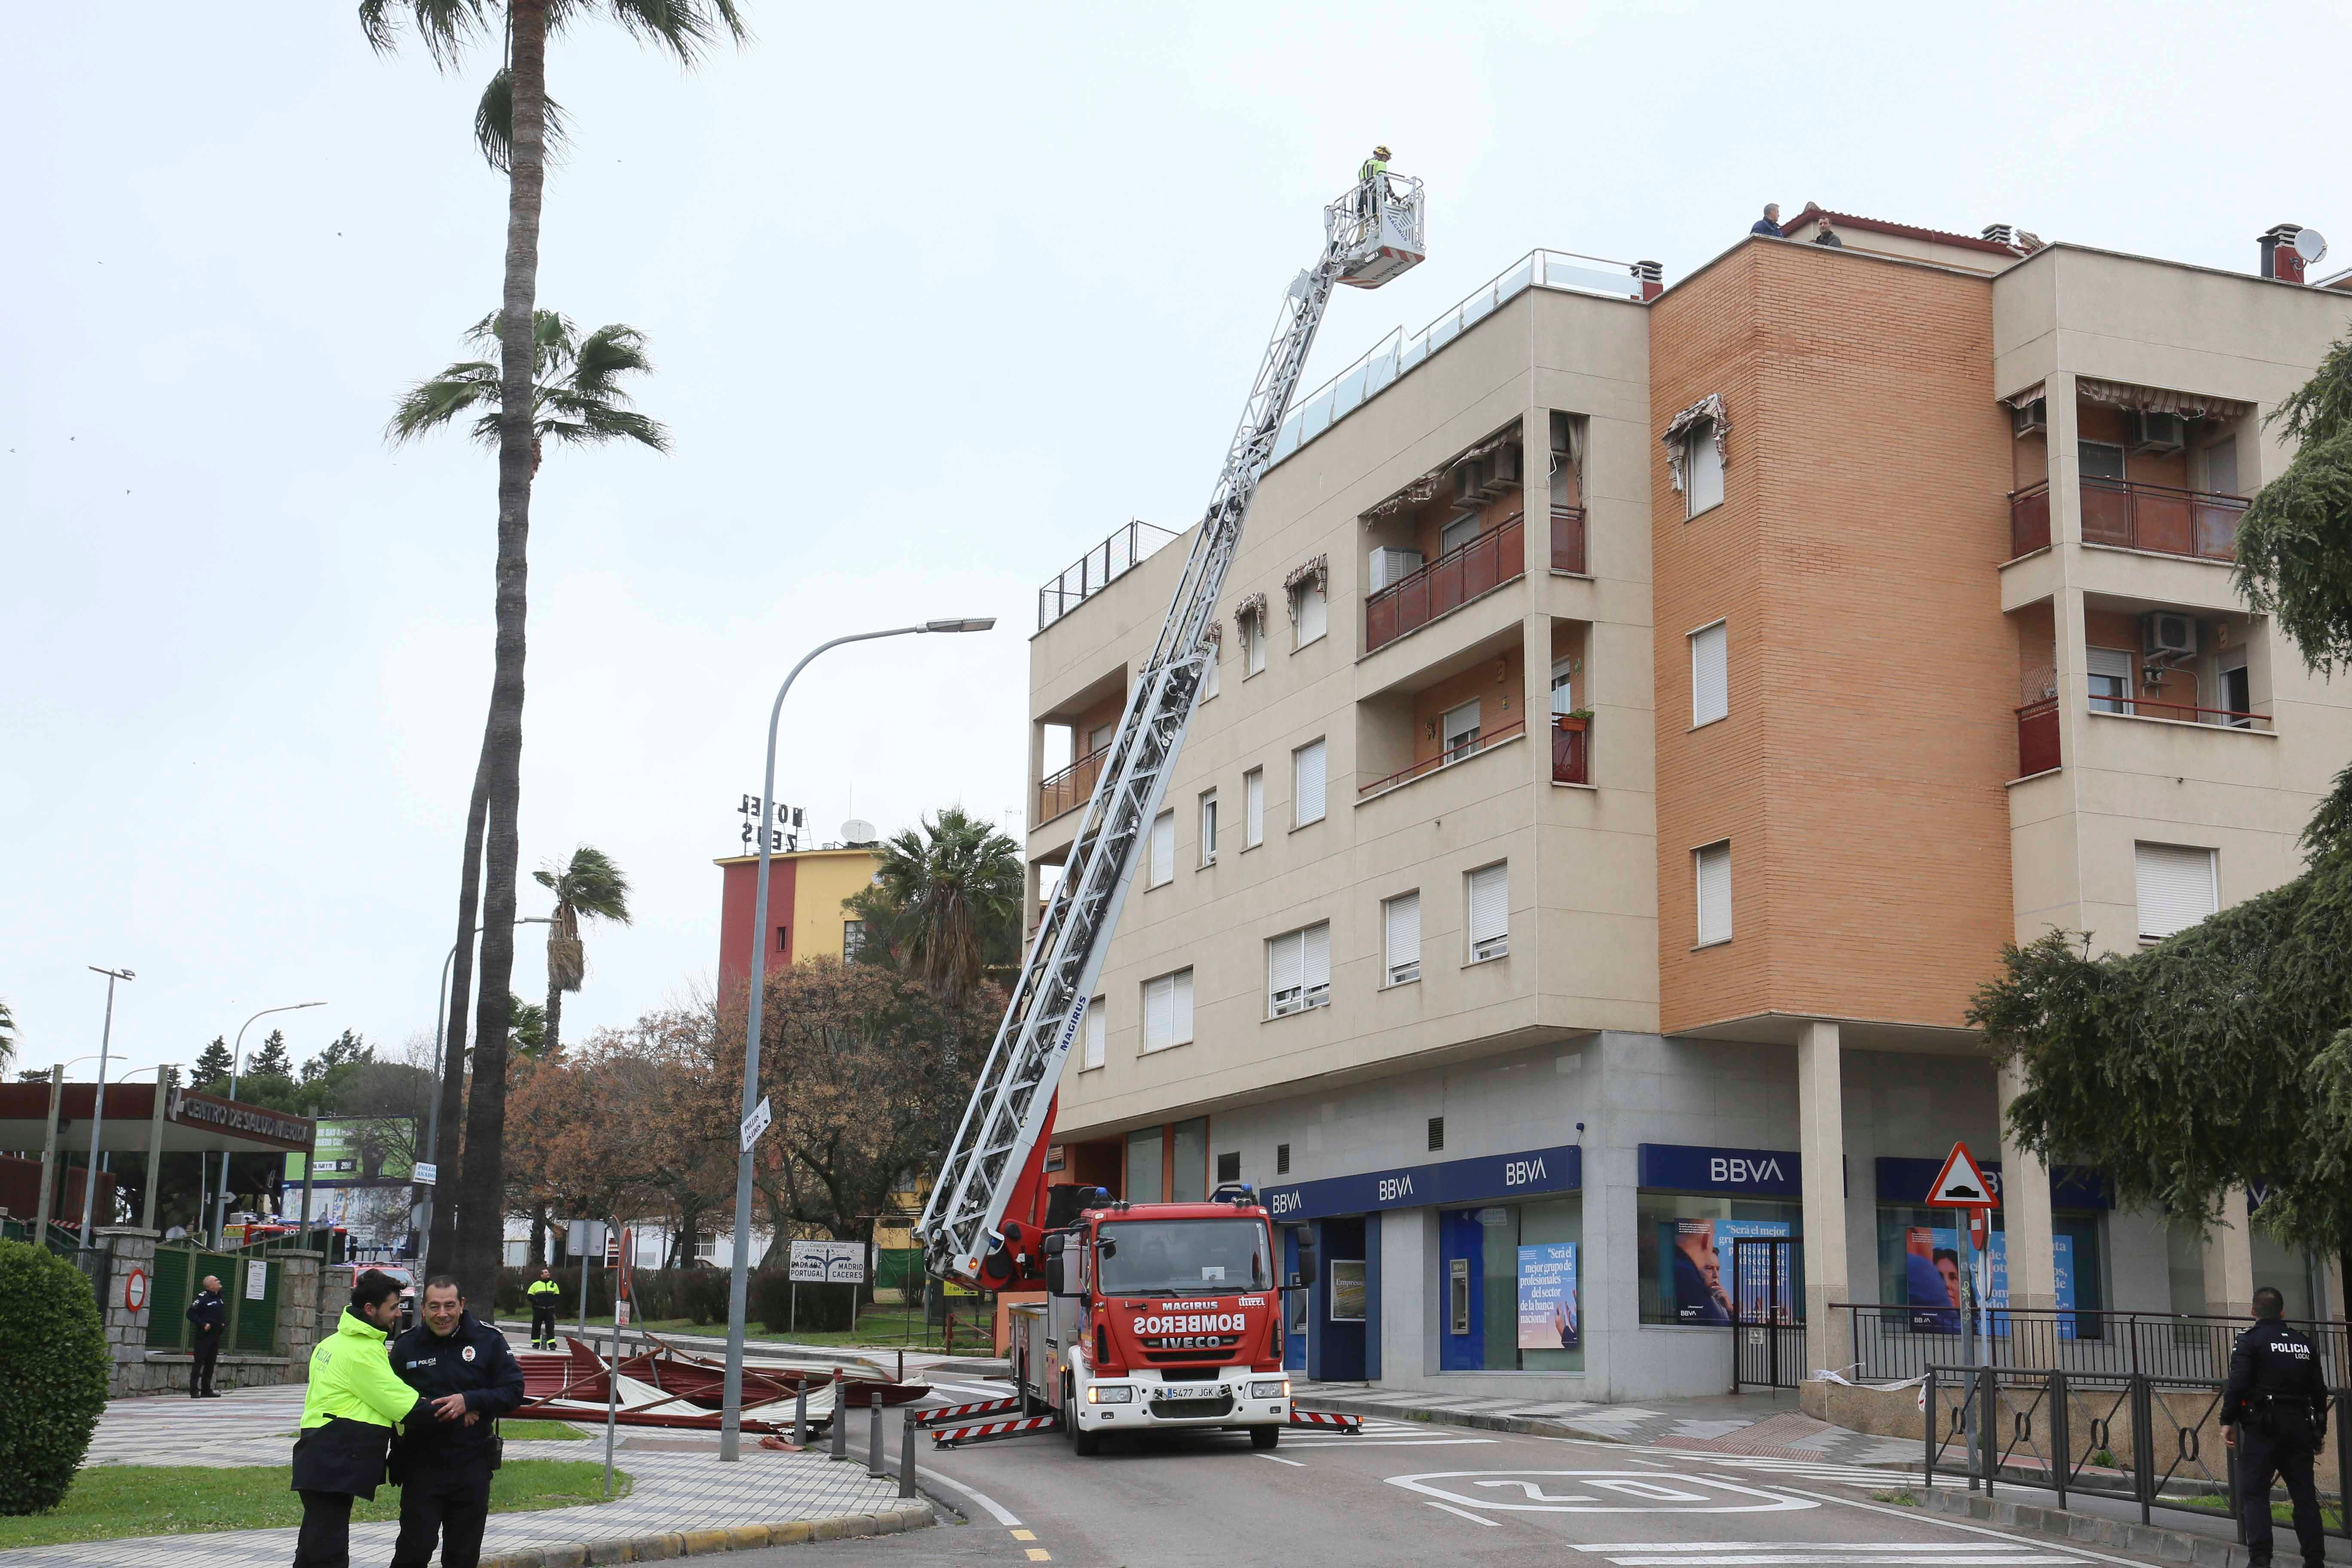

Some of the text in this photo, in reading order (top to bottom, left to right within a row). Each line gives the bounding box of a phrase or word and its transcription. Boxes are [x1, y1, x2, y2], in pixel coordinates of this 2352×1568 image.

[1387, 214, 1408, 242] MAGIRUS
[1060, 995, 1086, 1051] MAGIRUS
[185, 1097, 227, 1124] CENTRO
[229, 1108, 243, 1128] DE
[243, 1111, 274, 1135] SALUD
[744, 1112, 759, 1134] POLLOS
[746, 1122, 761, 1143] ASADOS
[1506, 1157, 1547, 1185] BBVA
[1711, 1158, 1784, 1182] BBVA
[1379, 1174, 1413, 1200] BBVA
[1273, 1189, 1302, 1214] BBVA
[1726, 1225, 1786, 1237] “Será el mejor
[1719, 1236, 1733, 1245] gru
[1548, 1247, 1565, 1259] “Será
[1565, 1246, 1571, 1258] el
[1525, 1259, 1572, 1275] mejor grupo de
[1762, 1266, 1787, 1276] baca
[1520, 1273, 1561, 1289] profesionales
[1531, 1286, 1561, 1298] del sector
[1162, 1302, 1218, 1311] MAGIRUS
[1520, 1299, 1554, 1311] de la banca
[1520, 1311, 1550, 1324] nacional”
[1162, 1336, 1220, 1349] IVECO
[2270, 1343, 2310, 1354] POLICIA
[1173, 1389, 1193, 1397] 5477
